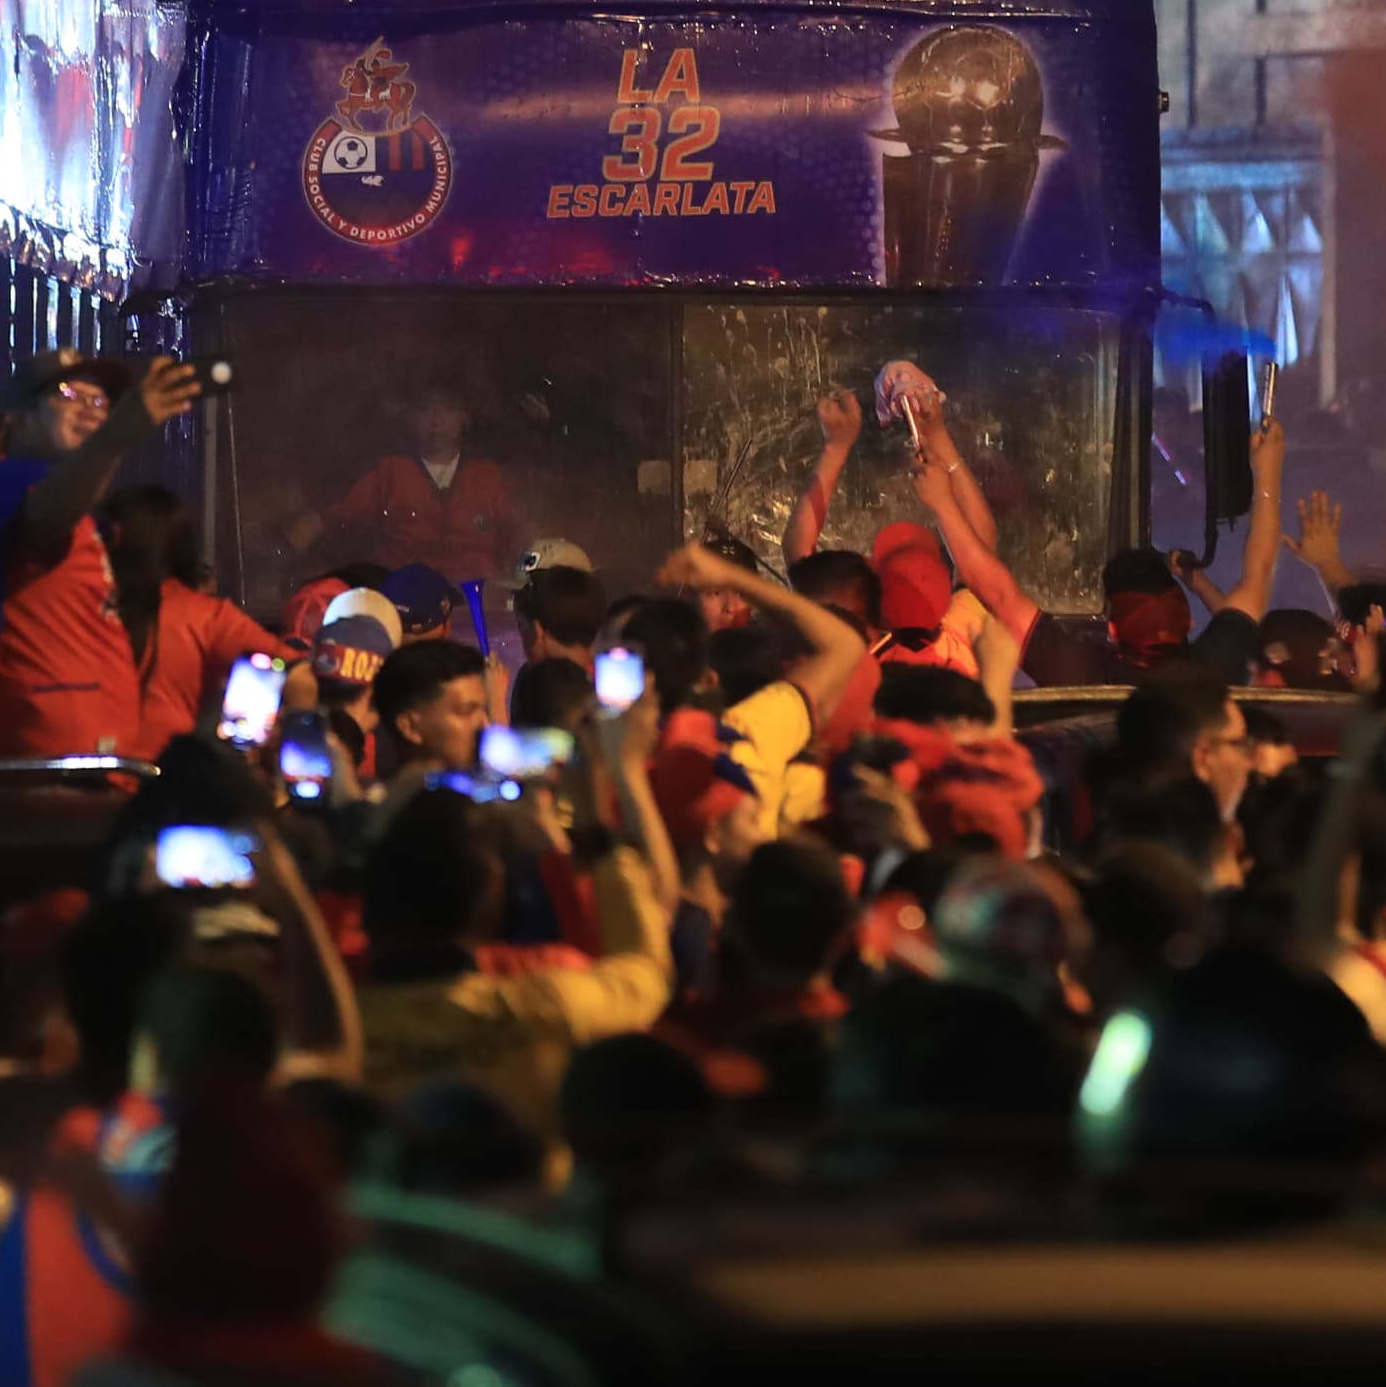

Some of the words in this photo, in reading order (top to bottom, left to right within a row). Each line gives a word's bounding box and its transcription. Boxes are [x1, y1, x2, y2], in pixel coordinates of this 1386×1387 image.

[616, 47, 701, 104] LA
[309, 137, 326, 172] CLUB
[601, 106, 721, 182] 32
[425, 135, 447, 215] MUNICIPAL
[308, 176, 336, 223] SOCIAL
[546, 181, 776, 219] ESCARLATA
[338, 220, 348, 231] Y
[350, 214, 426, 241] DEPORTIVO
